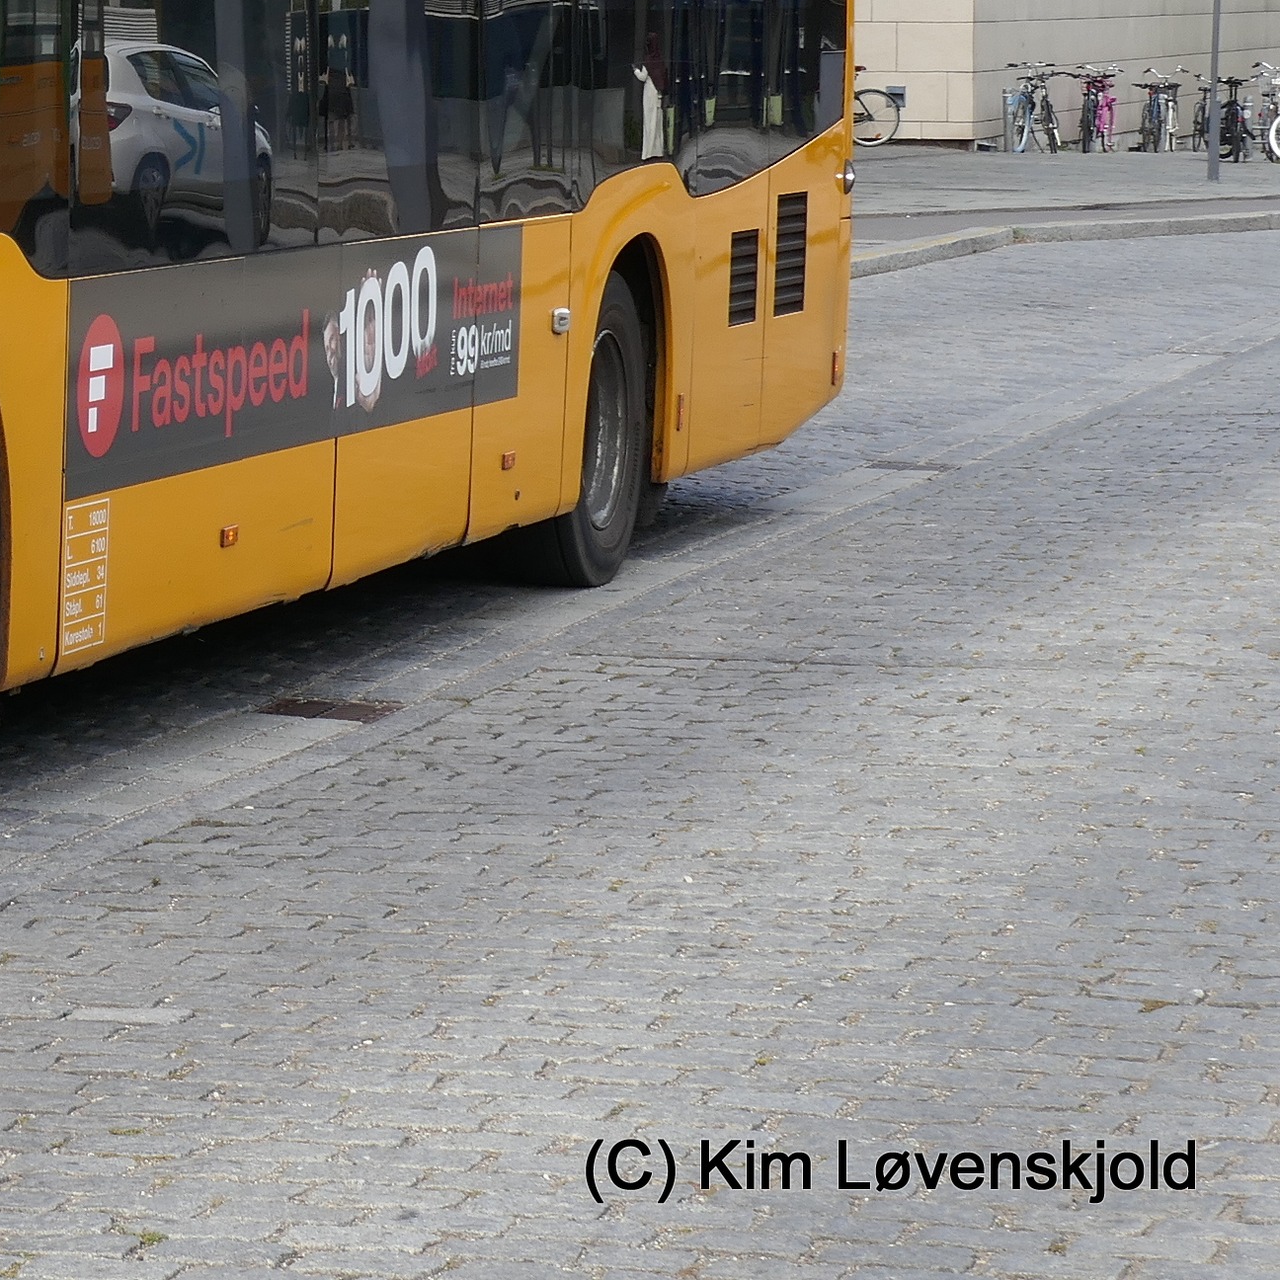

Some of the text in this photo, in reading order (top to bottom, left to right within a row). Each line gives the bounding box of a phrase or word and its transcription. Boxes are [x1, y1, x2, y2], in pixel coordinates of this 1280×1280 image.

[453, 271, 514, 320] Internet
[340, 246, 437, 408] 1000
[456, 320, 512, 376] 99 kr/md
[131, 309, 312, 437] Fastspeed
[89, 509, 106, 527] 18000
[91, 537, 105, 553] 6100
[96, 565, 105, 580] 34
[95, 594, 104, 609] 61
